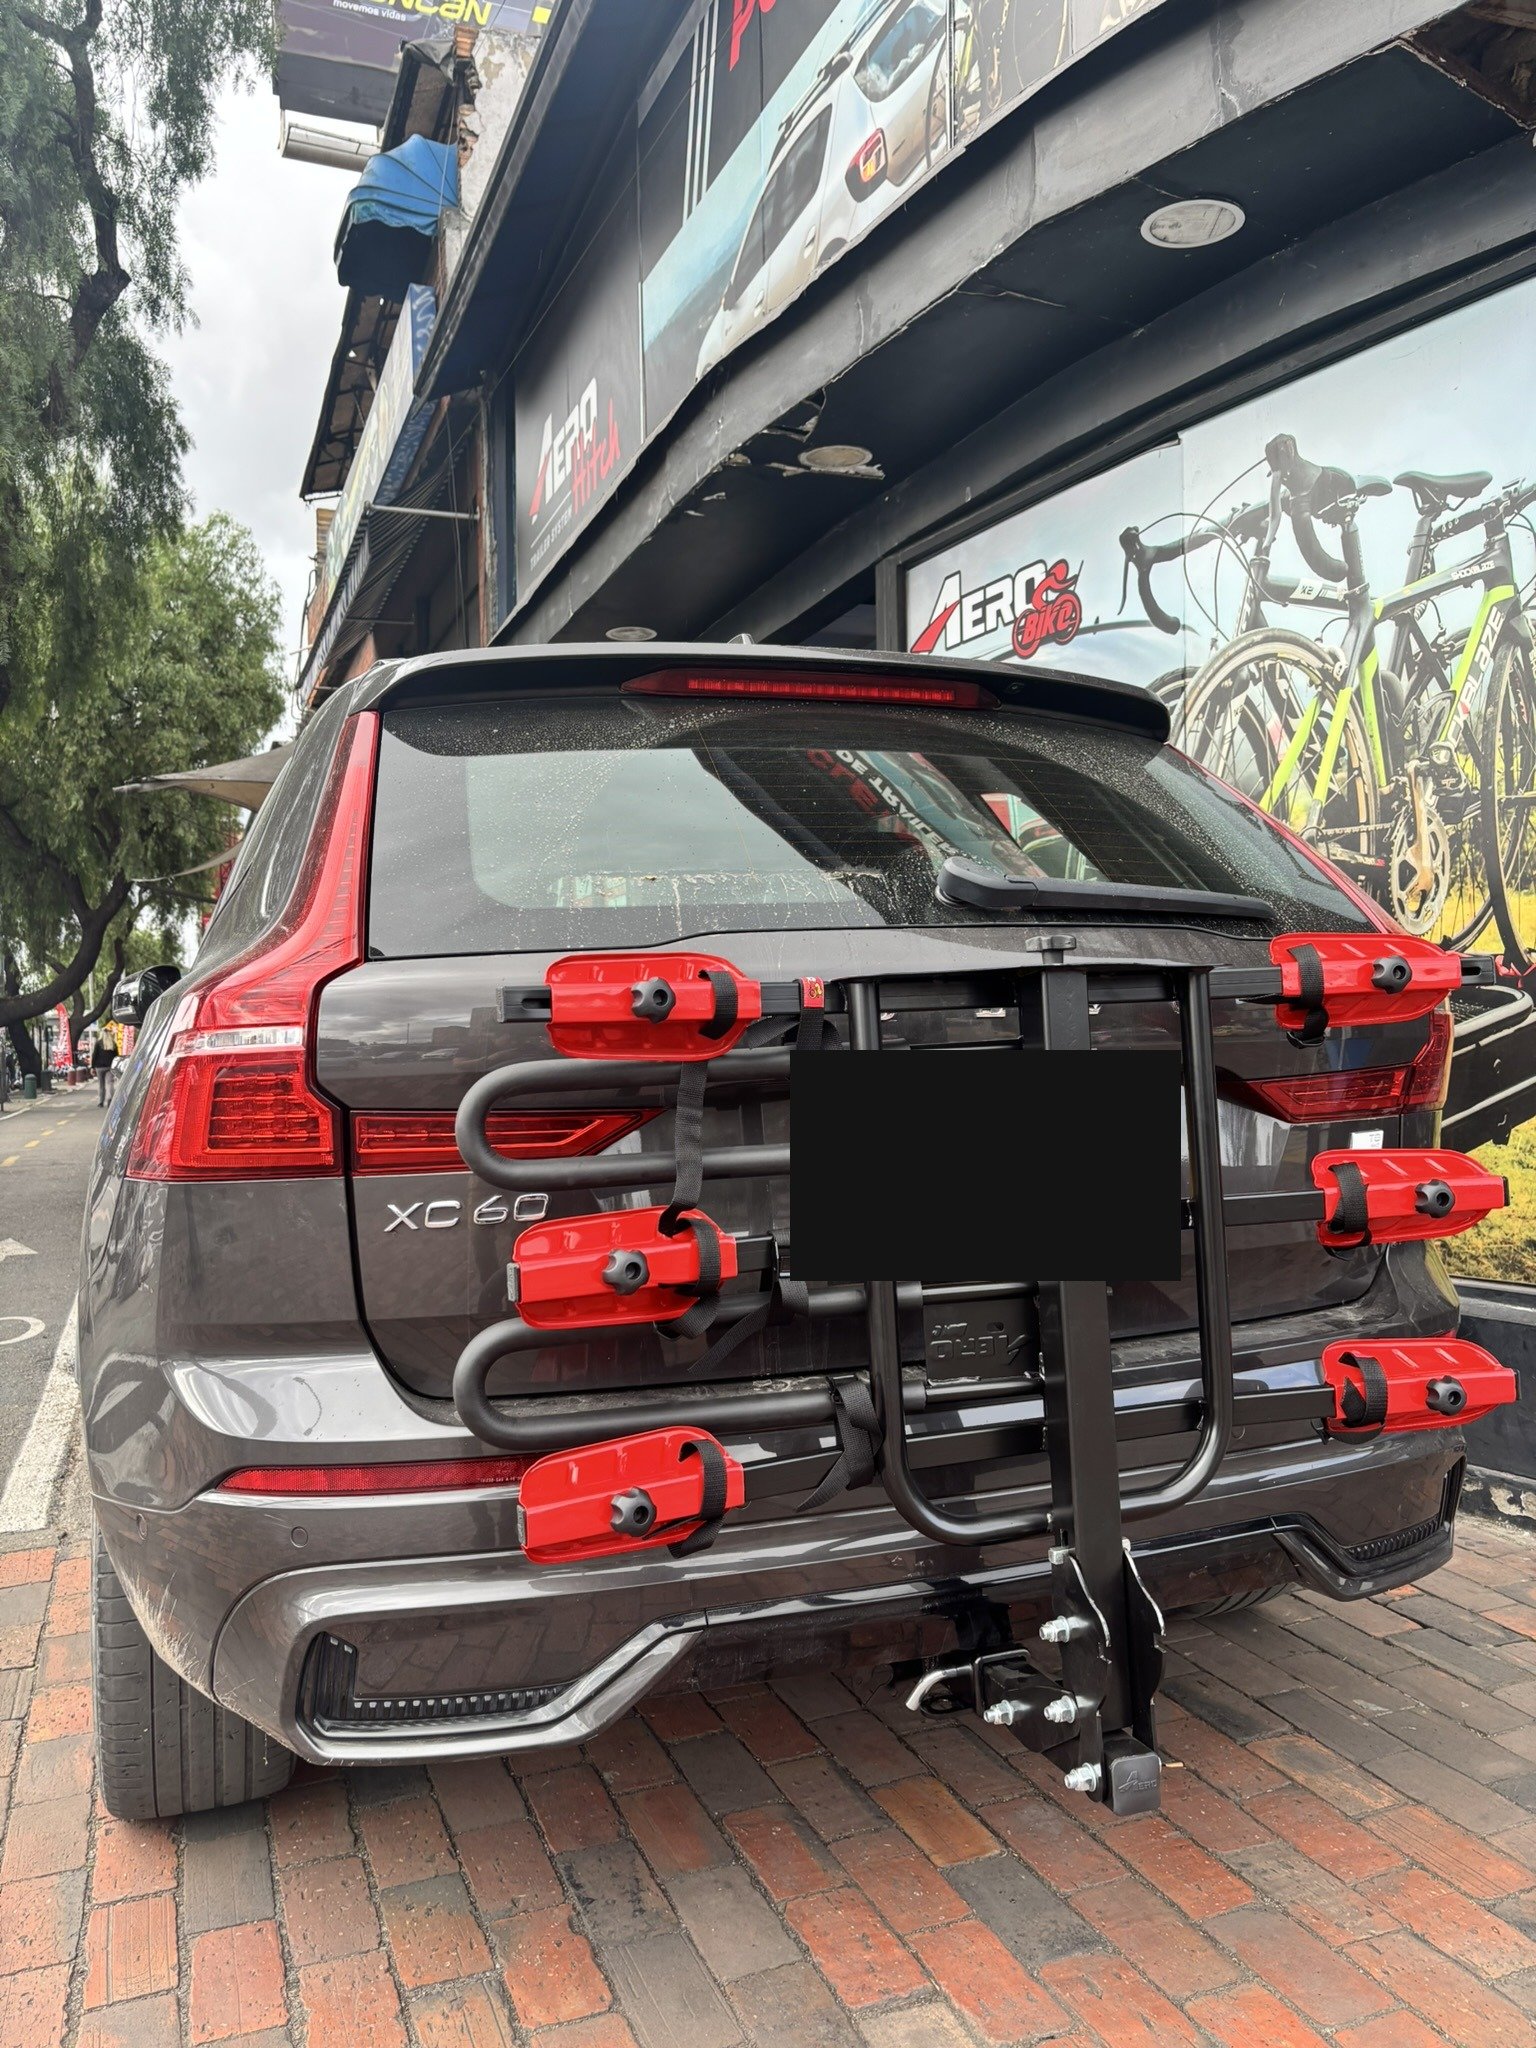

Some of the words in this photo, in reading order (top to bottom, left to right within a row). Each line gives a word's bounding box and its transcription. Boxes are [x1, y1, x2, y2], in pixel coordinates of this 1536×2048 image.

[333, 0, 379, 16] movemos
[381, 8, 407, 22] vidas
[910, 558, 1048, 655] AERO
